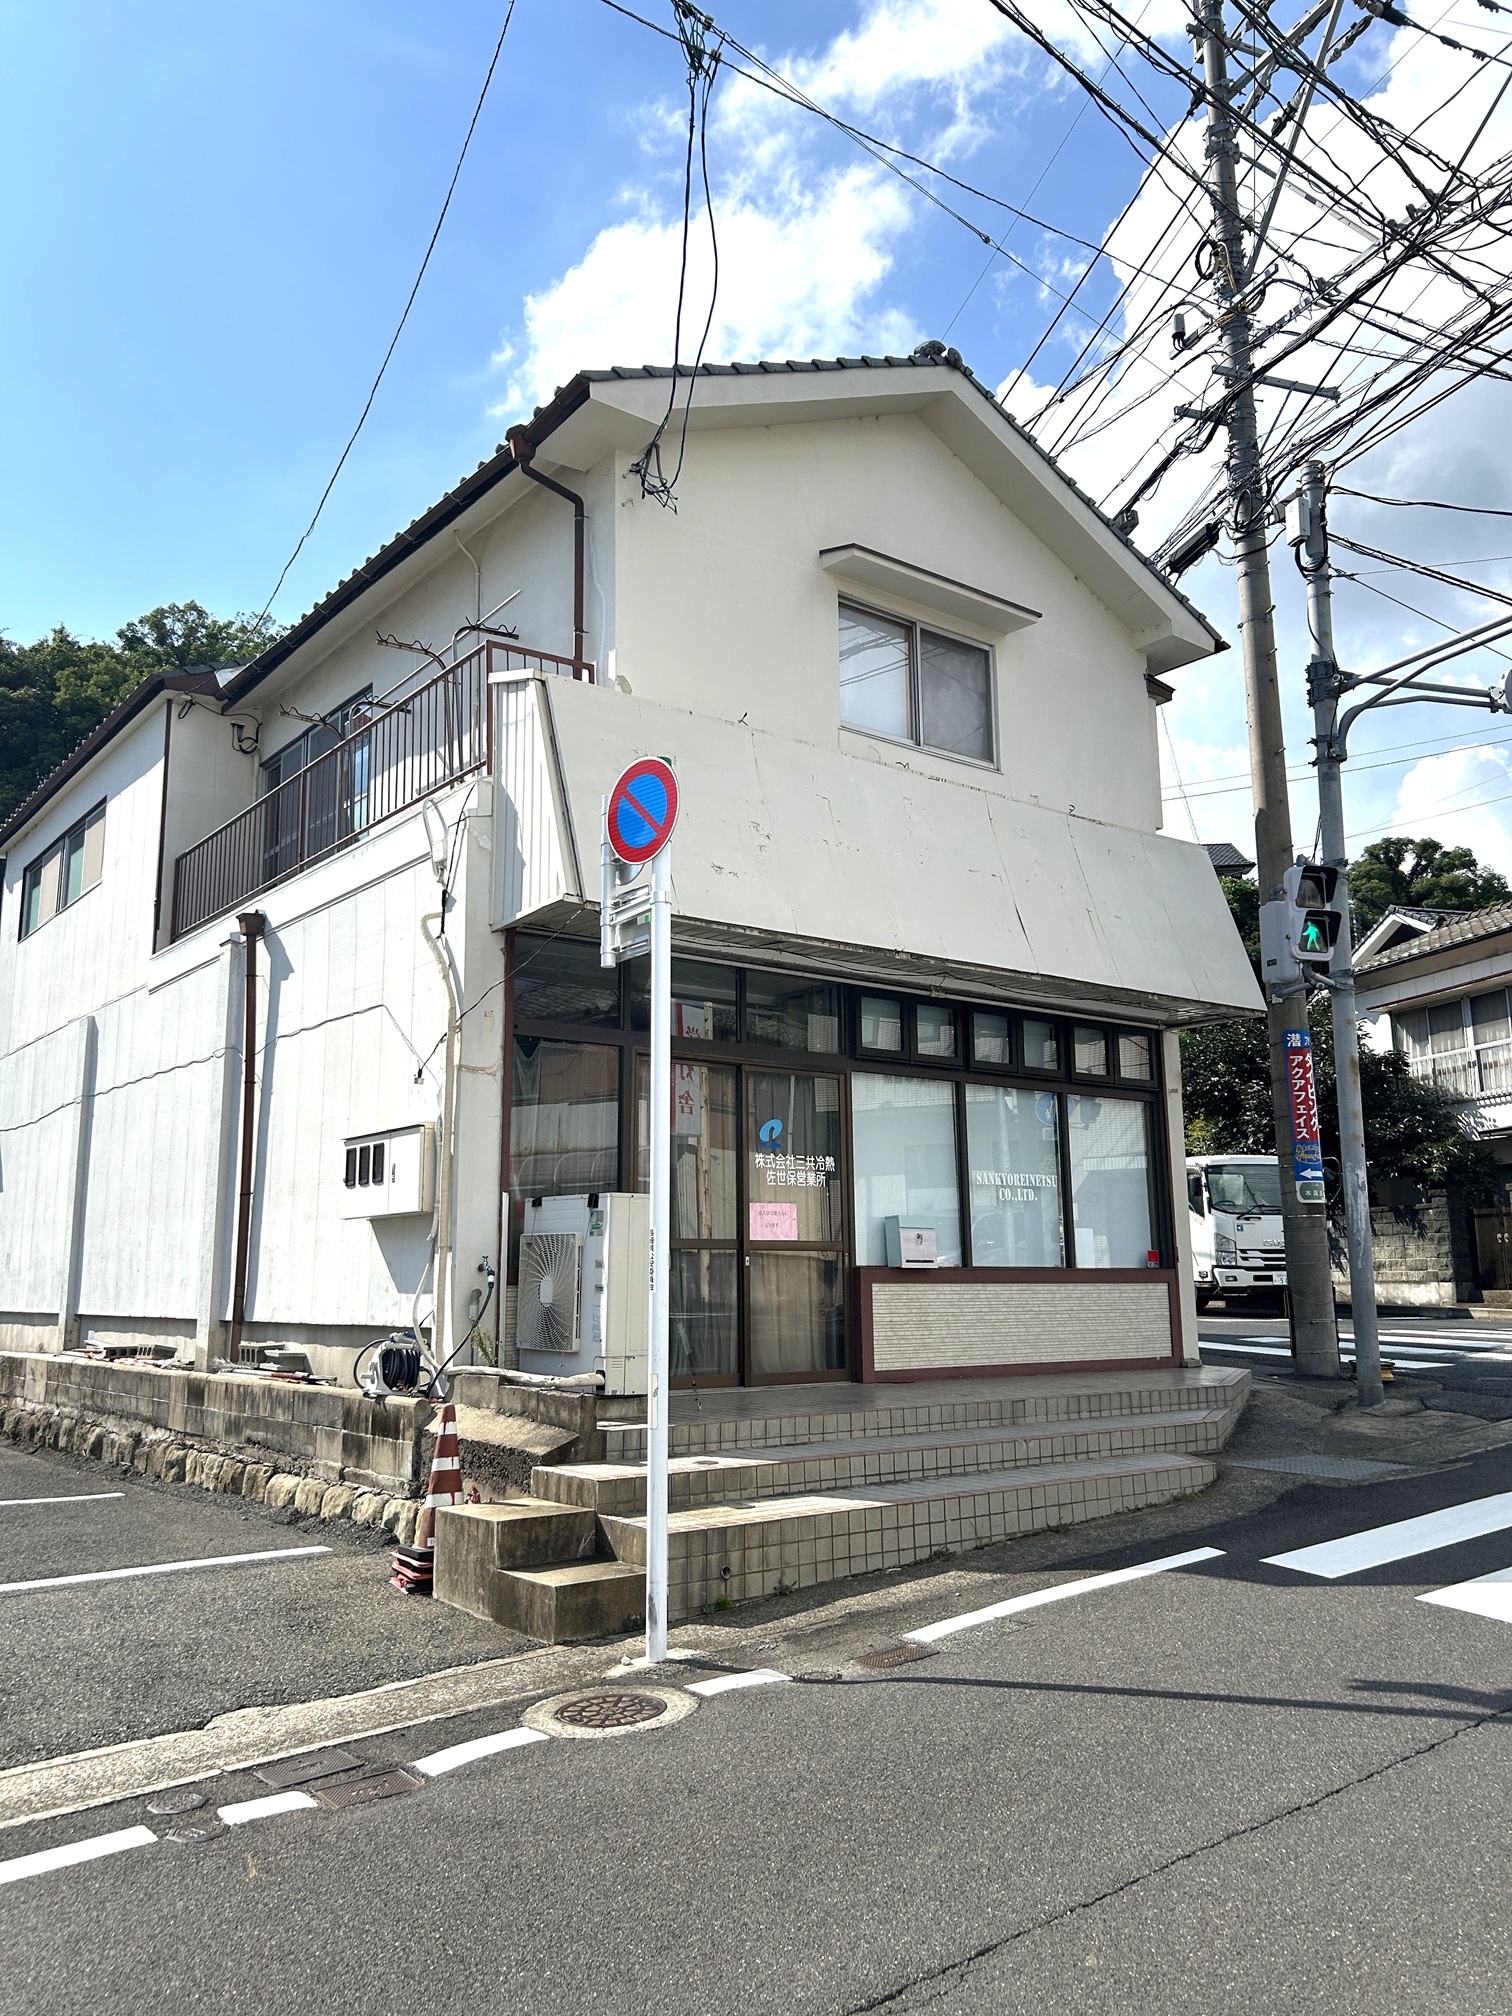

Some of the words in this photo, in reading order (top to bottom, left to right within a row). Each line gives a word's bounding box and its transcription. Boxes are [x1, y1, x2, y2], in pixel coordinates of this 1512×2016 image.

[1289, 1055, 1310, 1139] アクアフェイス
[754, 1153, 836, 1171] 株式会社三共冷熱
[766, 1169, 827, 1187] 佐世保営業所
[976, 1172, 1058, 1187] SANKYOREINETSU
